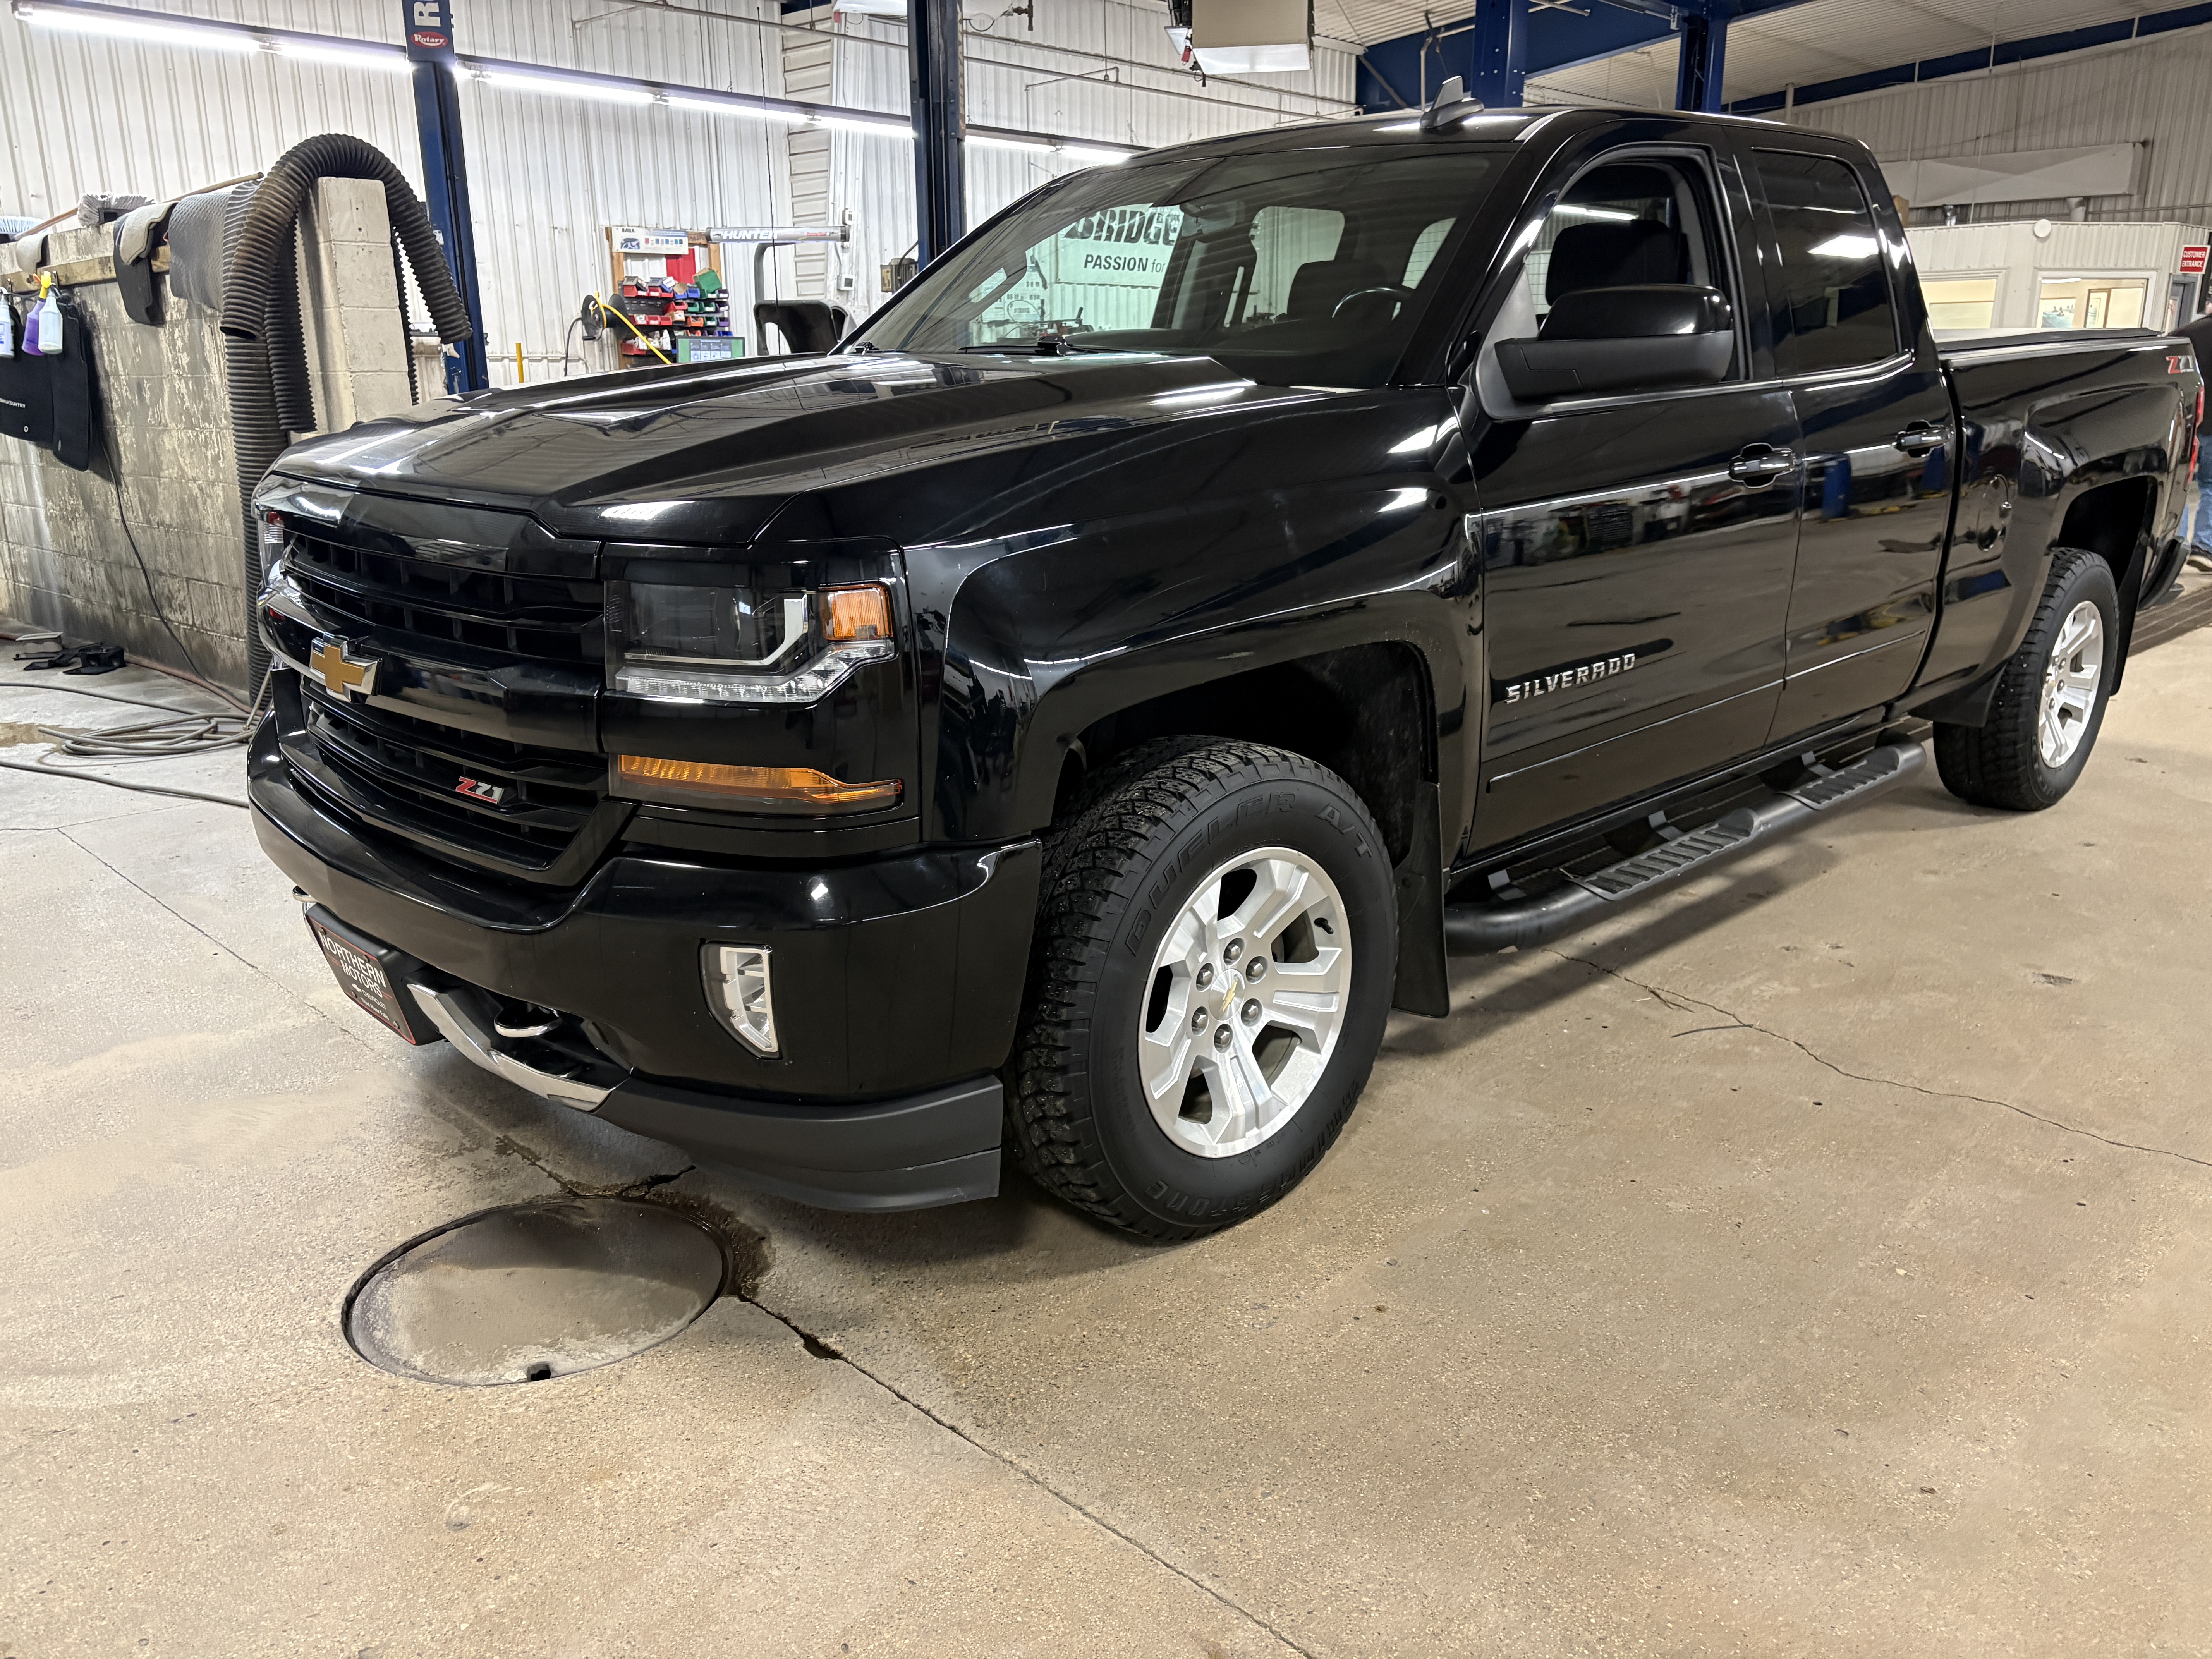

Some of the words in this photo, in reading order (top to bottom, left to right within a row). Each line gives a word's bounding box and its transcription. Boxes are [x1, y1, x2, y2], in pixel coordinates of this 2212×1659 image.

[413, 0, 441, 27] R
[414, 34, 445, 46] Rotary
[723, 230, 778, 239] HUNTER
[1084, 254, 1149, 271] PASSION
[1151, 259, 1166, 273] for
[2166, 355, 2194, 374] Z71
[1504, 653, 1635, 704] SILVERADO
[455, 776, 504, 804] Z71
[1125, 792, 1296, 957] DUELER
[1314, 802, 1373, 858] A/T
[318, 931, 386, 988] NORTHERN
[340, 960, 383, 998] MOTORS
[362, 989, 386, 1010] CHEVROLET
